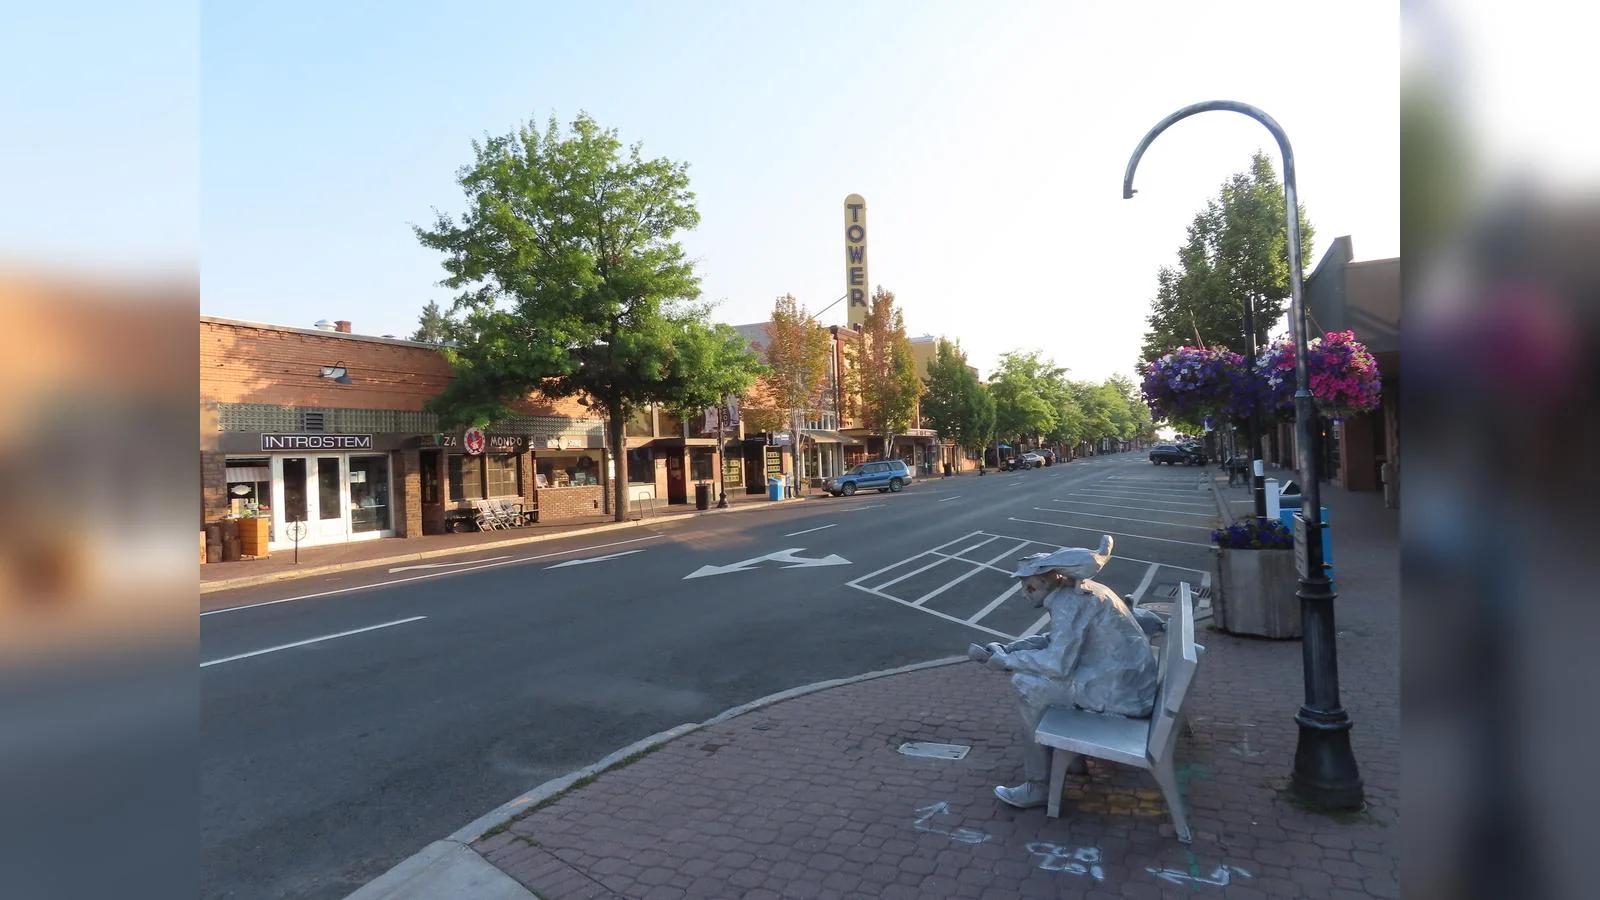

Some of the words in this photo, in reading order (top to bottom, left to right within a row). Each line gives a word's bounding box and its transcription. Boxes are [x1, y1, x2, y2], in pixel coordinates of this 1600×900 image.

[847, 203, 867, 307] TOWER
[265, 436, 370, 448] INTROSTEM
[490, 436, 523, 446] MONDO
